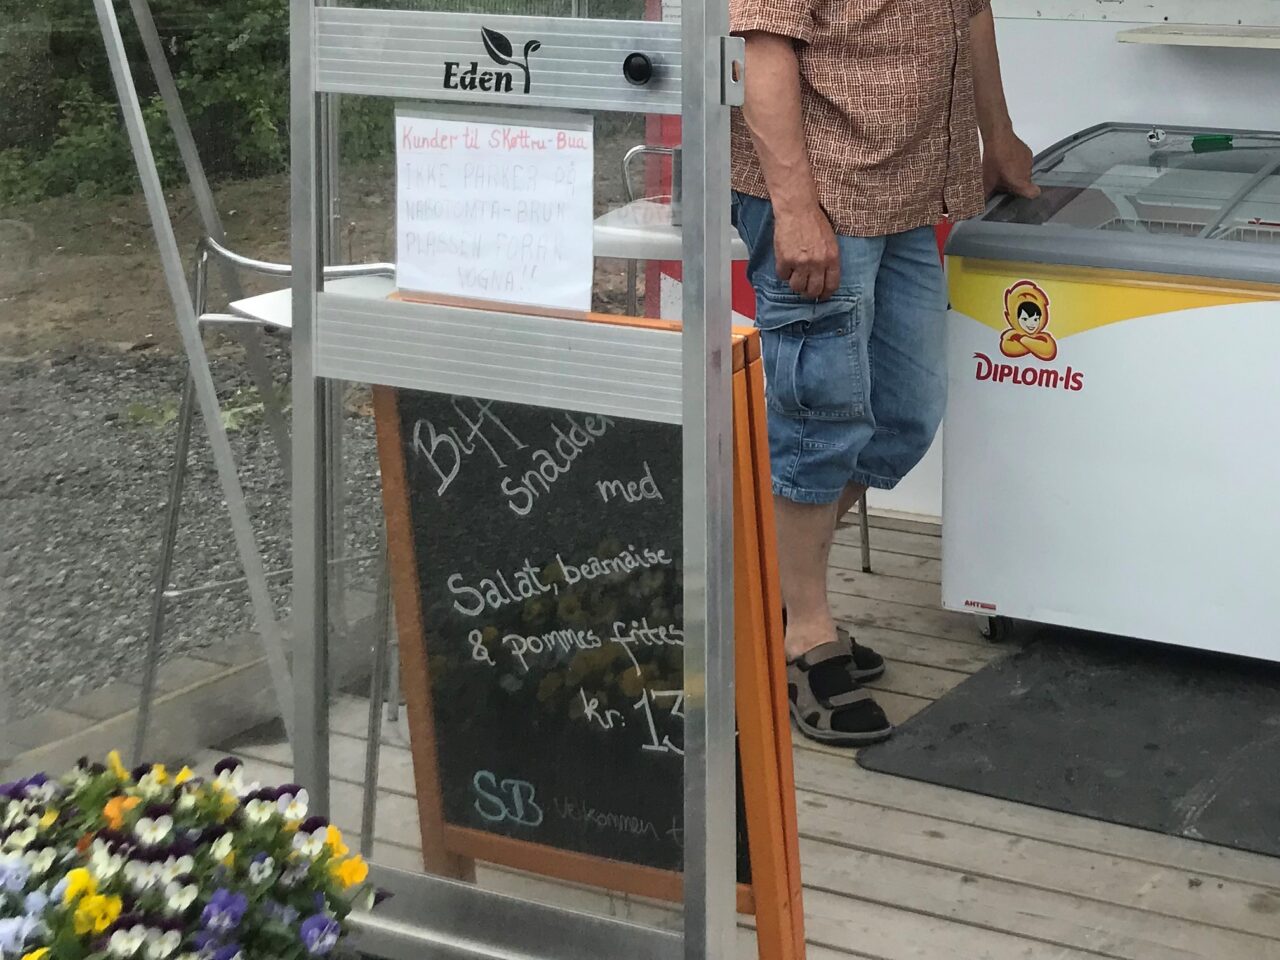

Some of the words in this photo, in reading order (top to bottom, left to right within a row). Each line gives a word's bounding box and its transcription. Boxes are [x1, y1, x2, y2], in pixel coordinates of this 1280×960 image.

[443, 61, 513, 93] Eden
[402, 126, 457, 150] Kunder
[463, 126, 480, 150] til
[596, 460, 663, 505] med
[556, 544, 673, 586] bearnaise
[473, 769, 543, 827] SB
